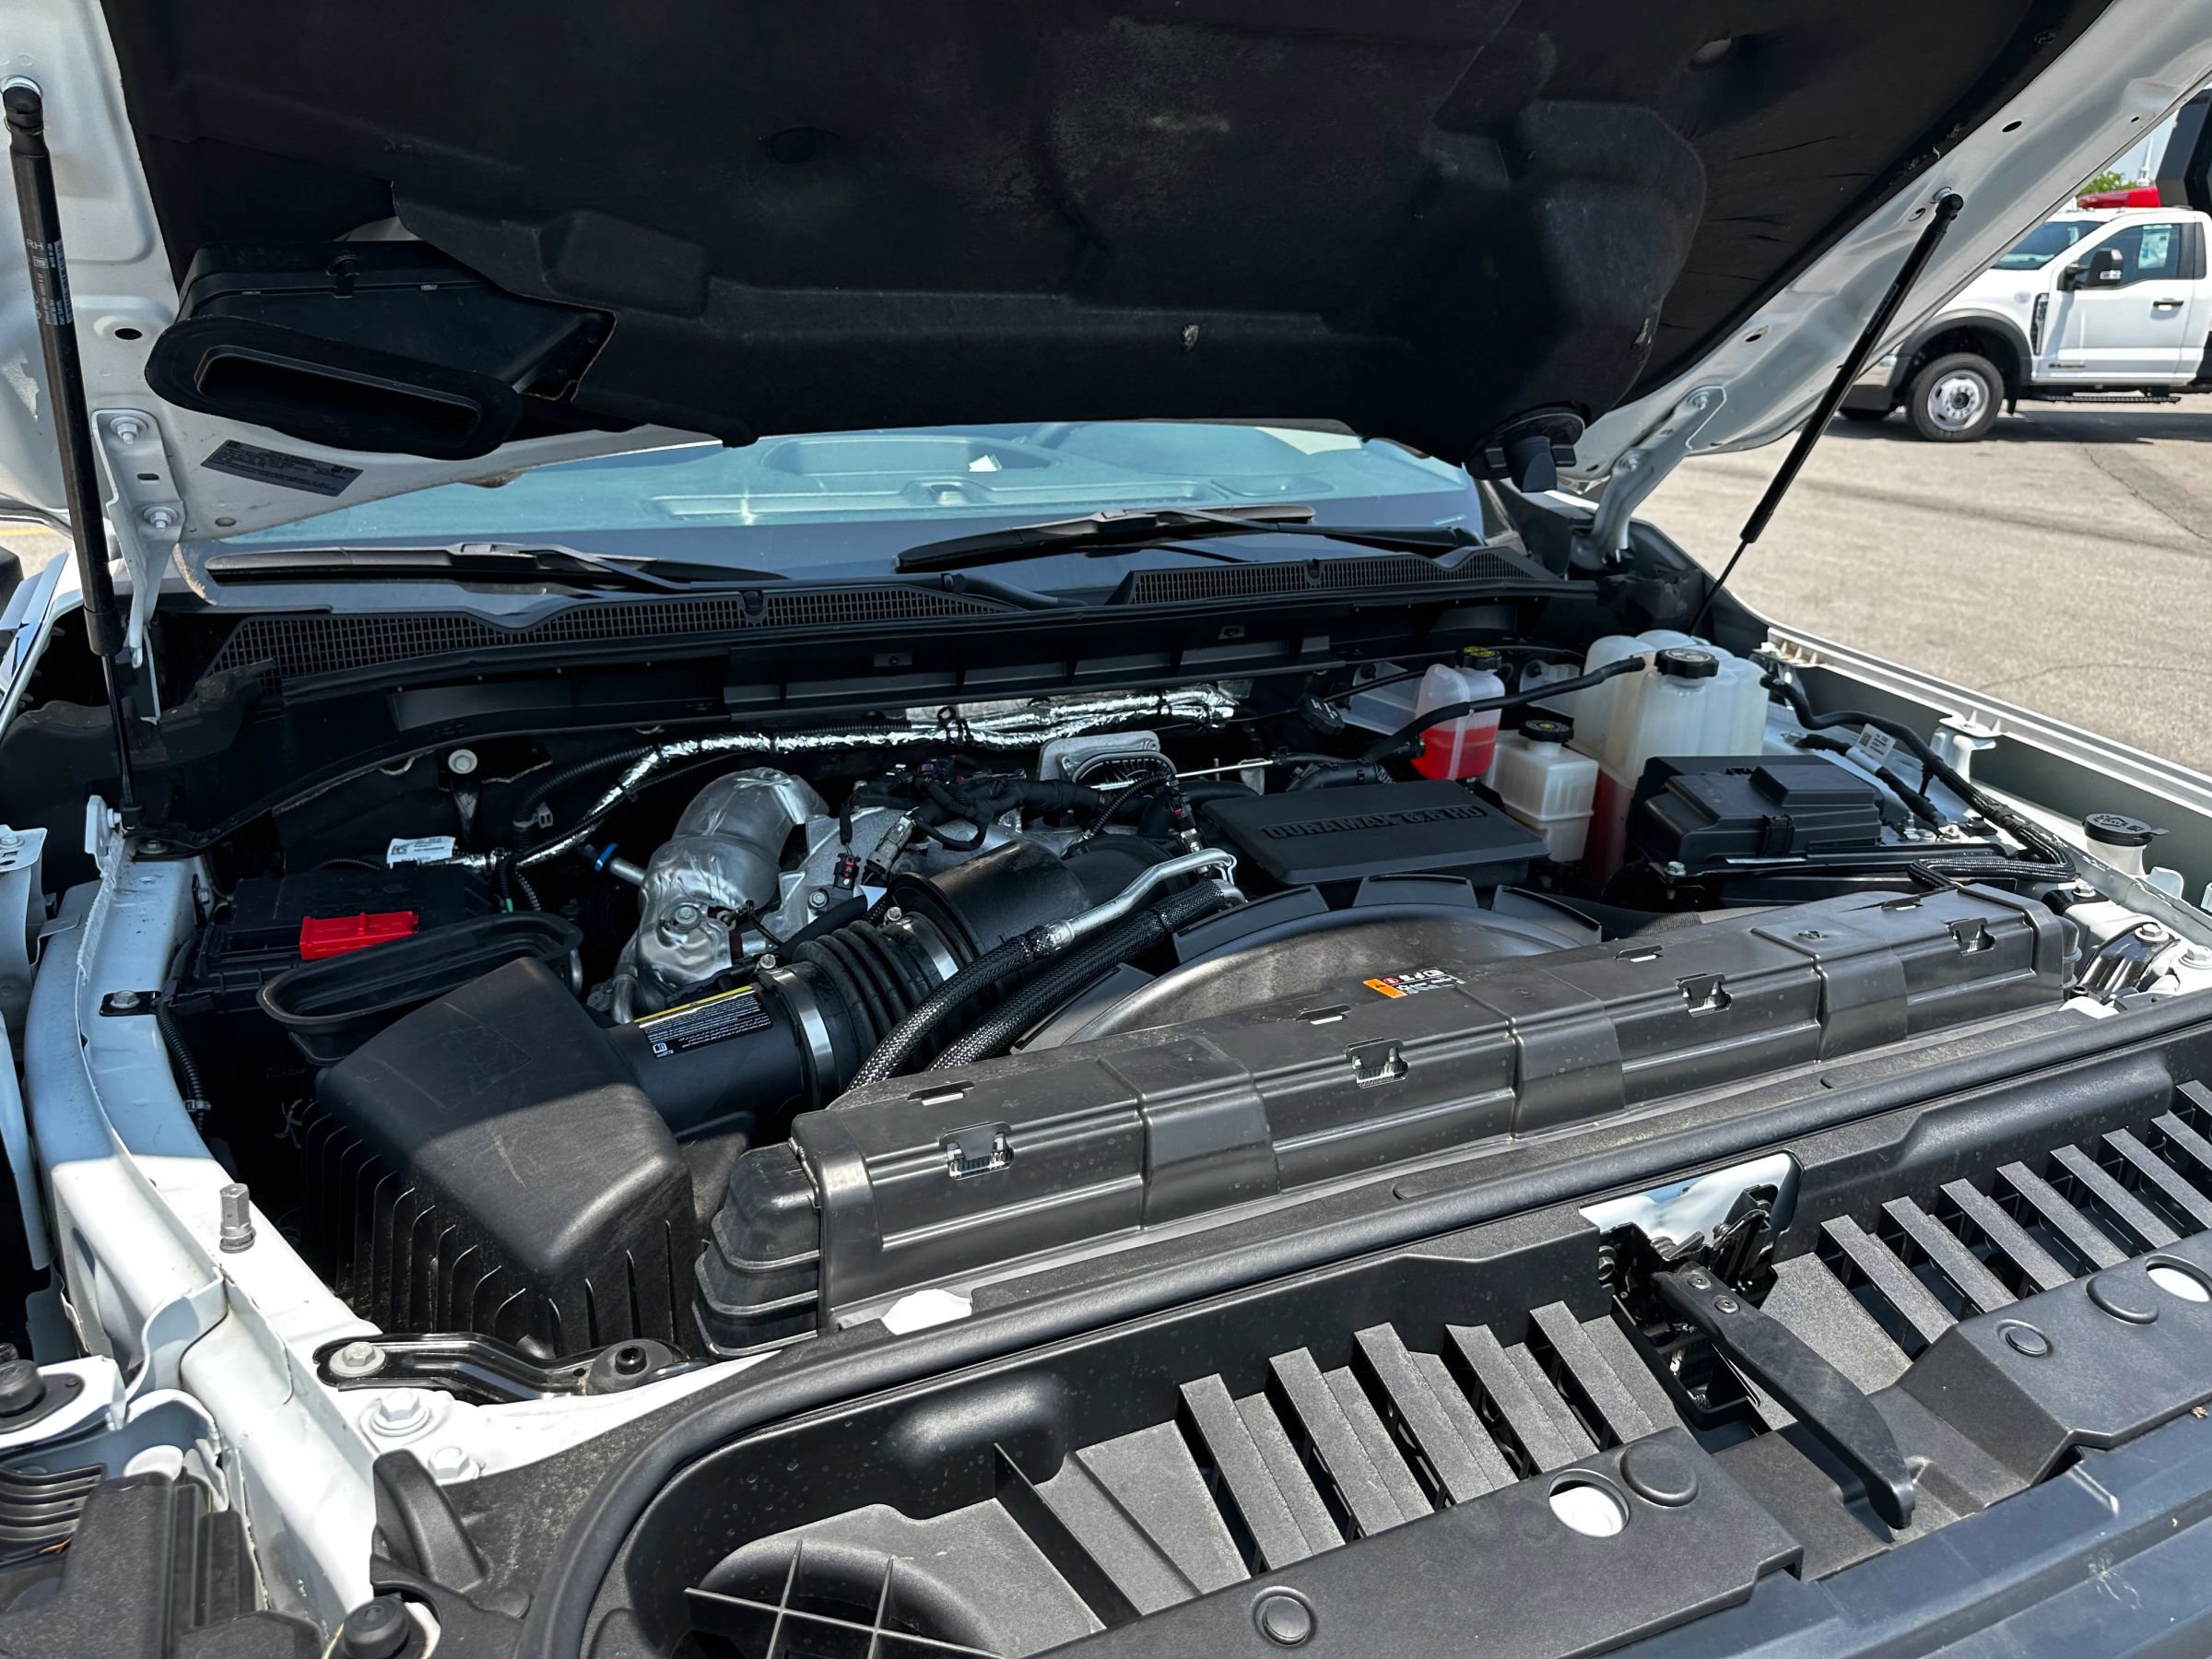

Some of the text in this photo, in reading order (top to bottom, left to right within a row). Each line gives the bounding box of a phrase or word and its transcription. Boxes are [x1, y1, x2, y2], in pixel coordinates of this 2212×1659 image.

[27, 239, 44, 251] RH
[1264, 806, 1482, 838] DURAMAX 6.6 HD
